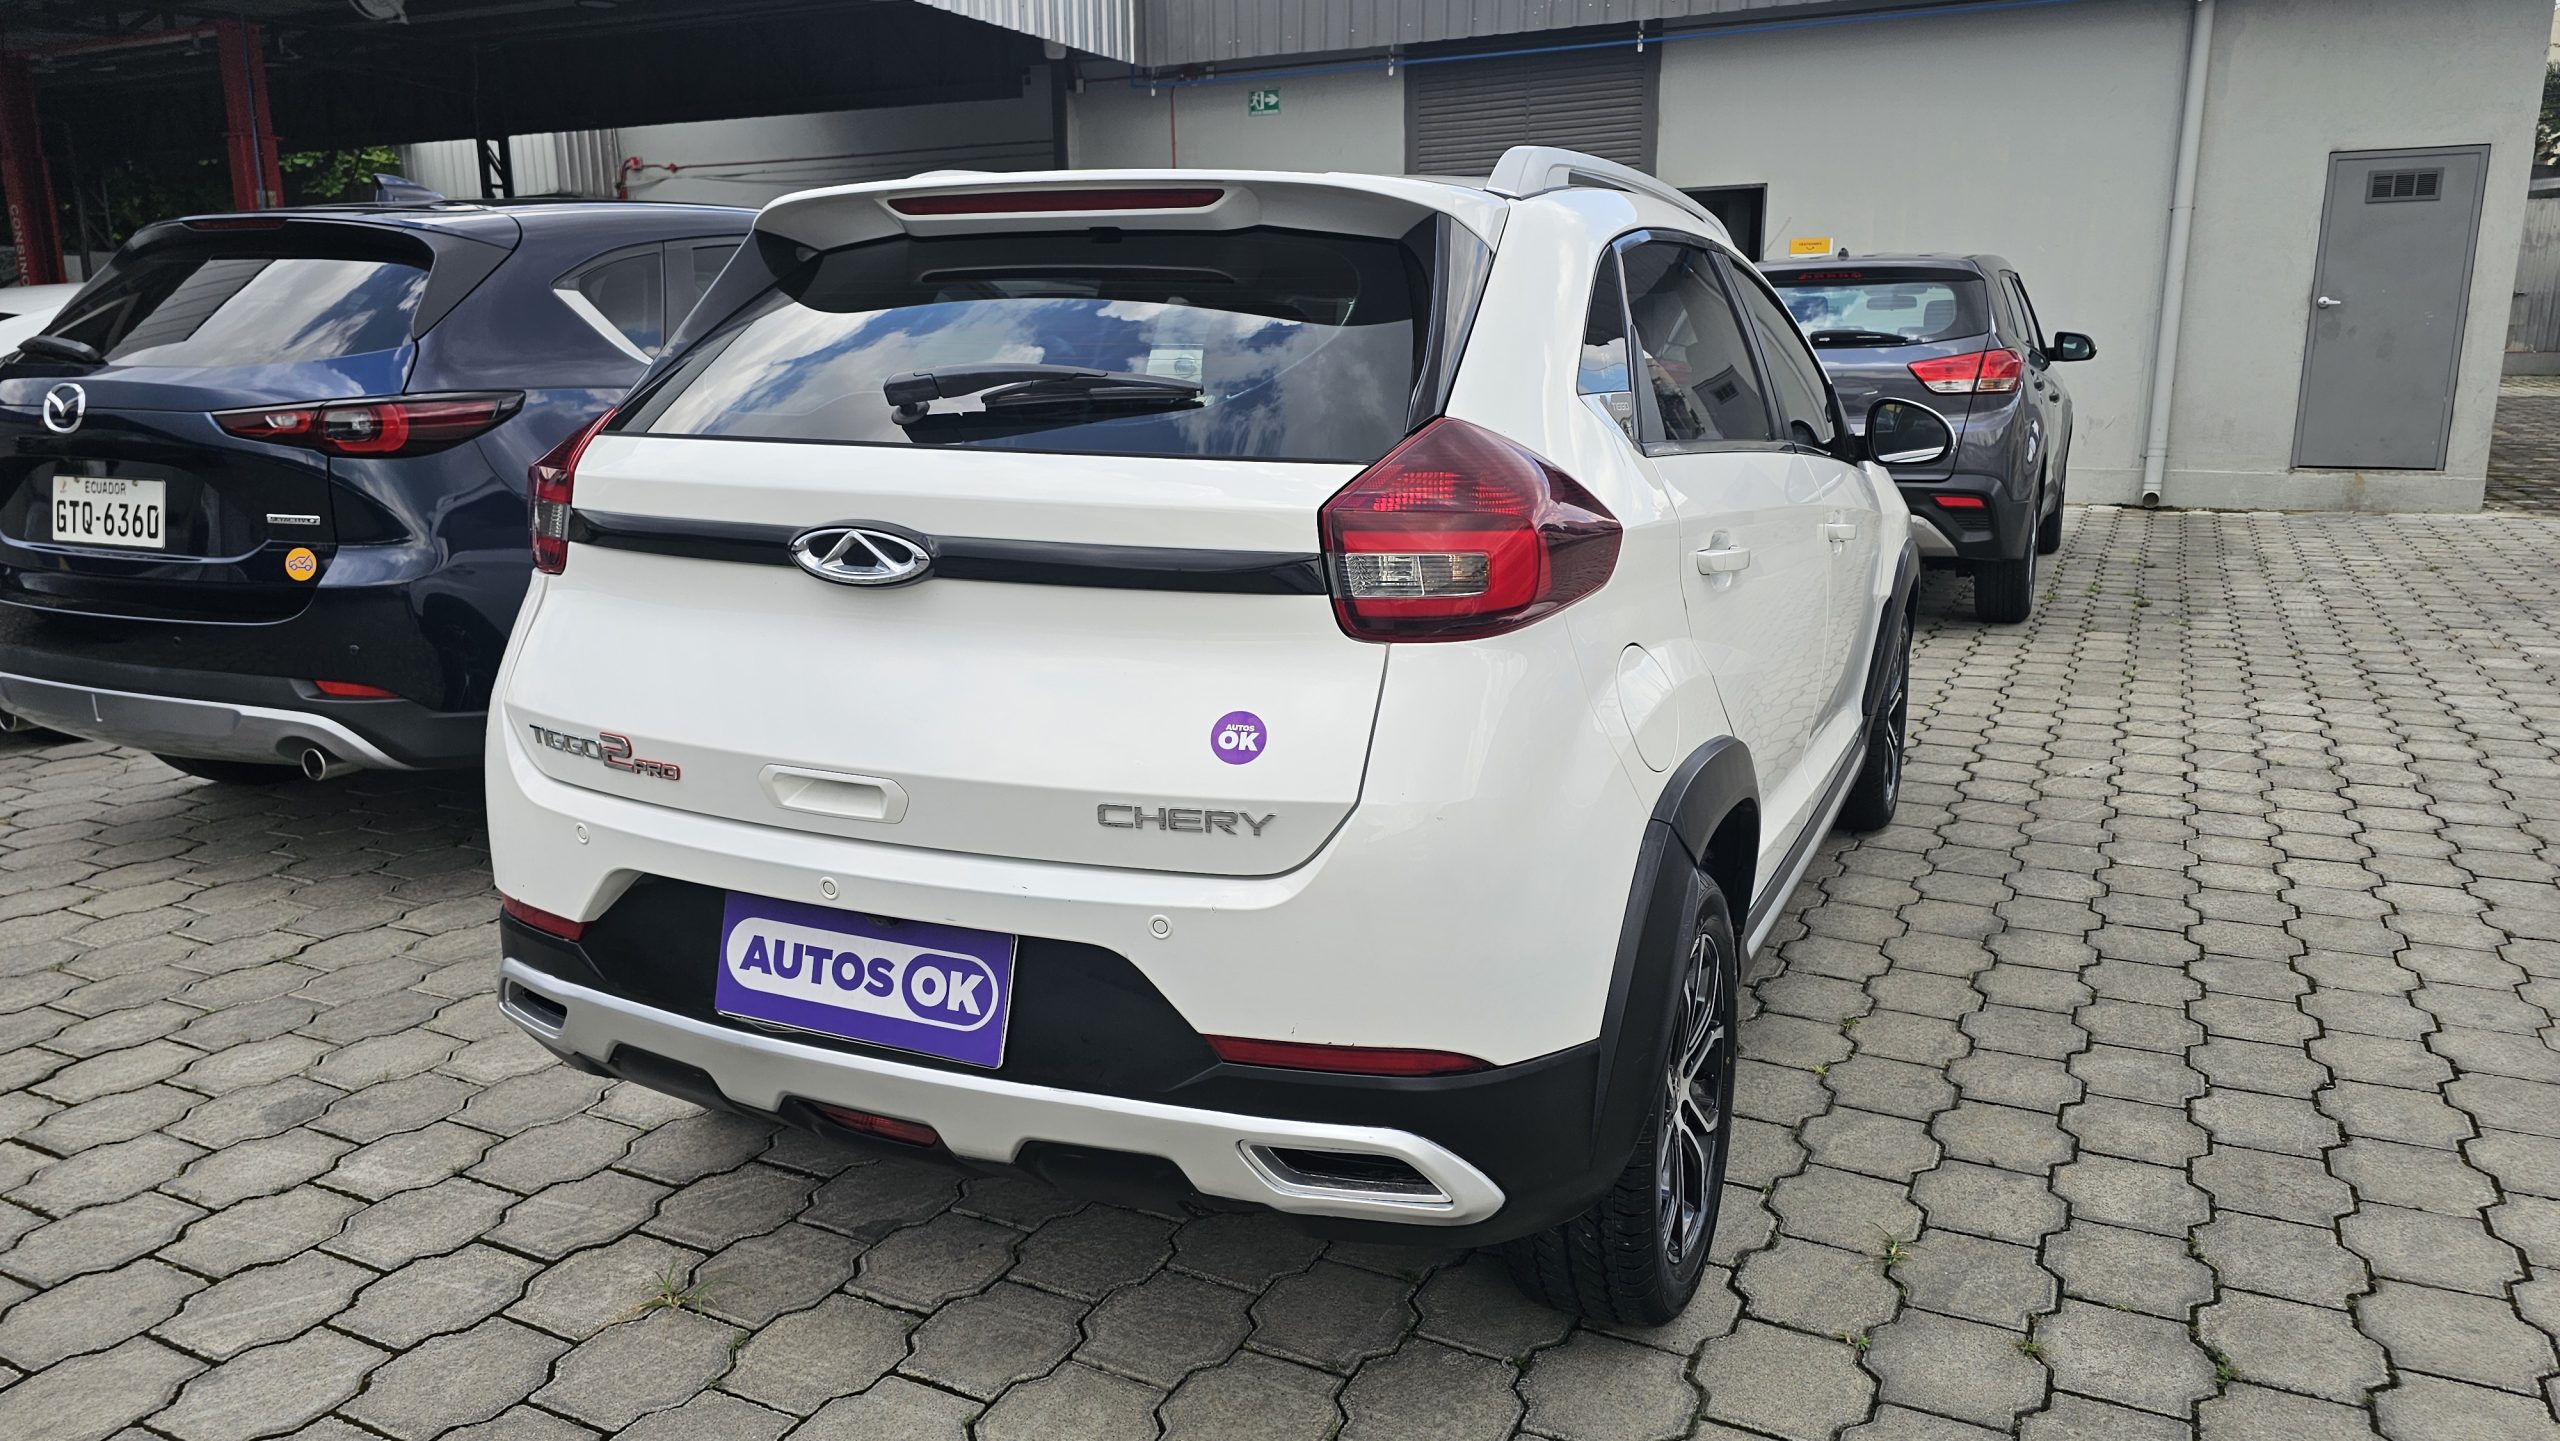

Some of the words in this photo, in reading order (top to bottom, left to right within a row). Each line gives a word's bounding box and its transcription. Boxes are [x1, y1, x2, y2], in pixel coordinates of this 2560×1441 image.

[85, 481, 127, 495] ECUADOR
[56, 500, 160, 539] GTQ-6360
[1217, 730, 1261, 752] OK
[1225, 723, 1255, 732] AUTOS
[1097, 803, 1277, 837] CHERY
[739, 934, 896, 998] AUTOS
[910, 965, 985, 1016] OK
